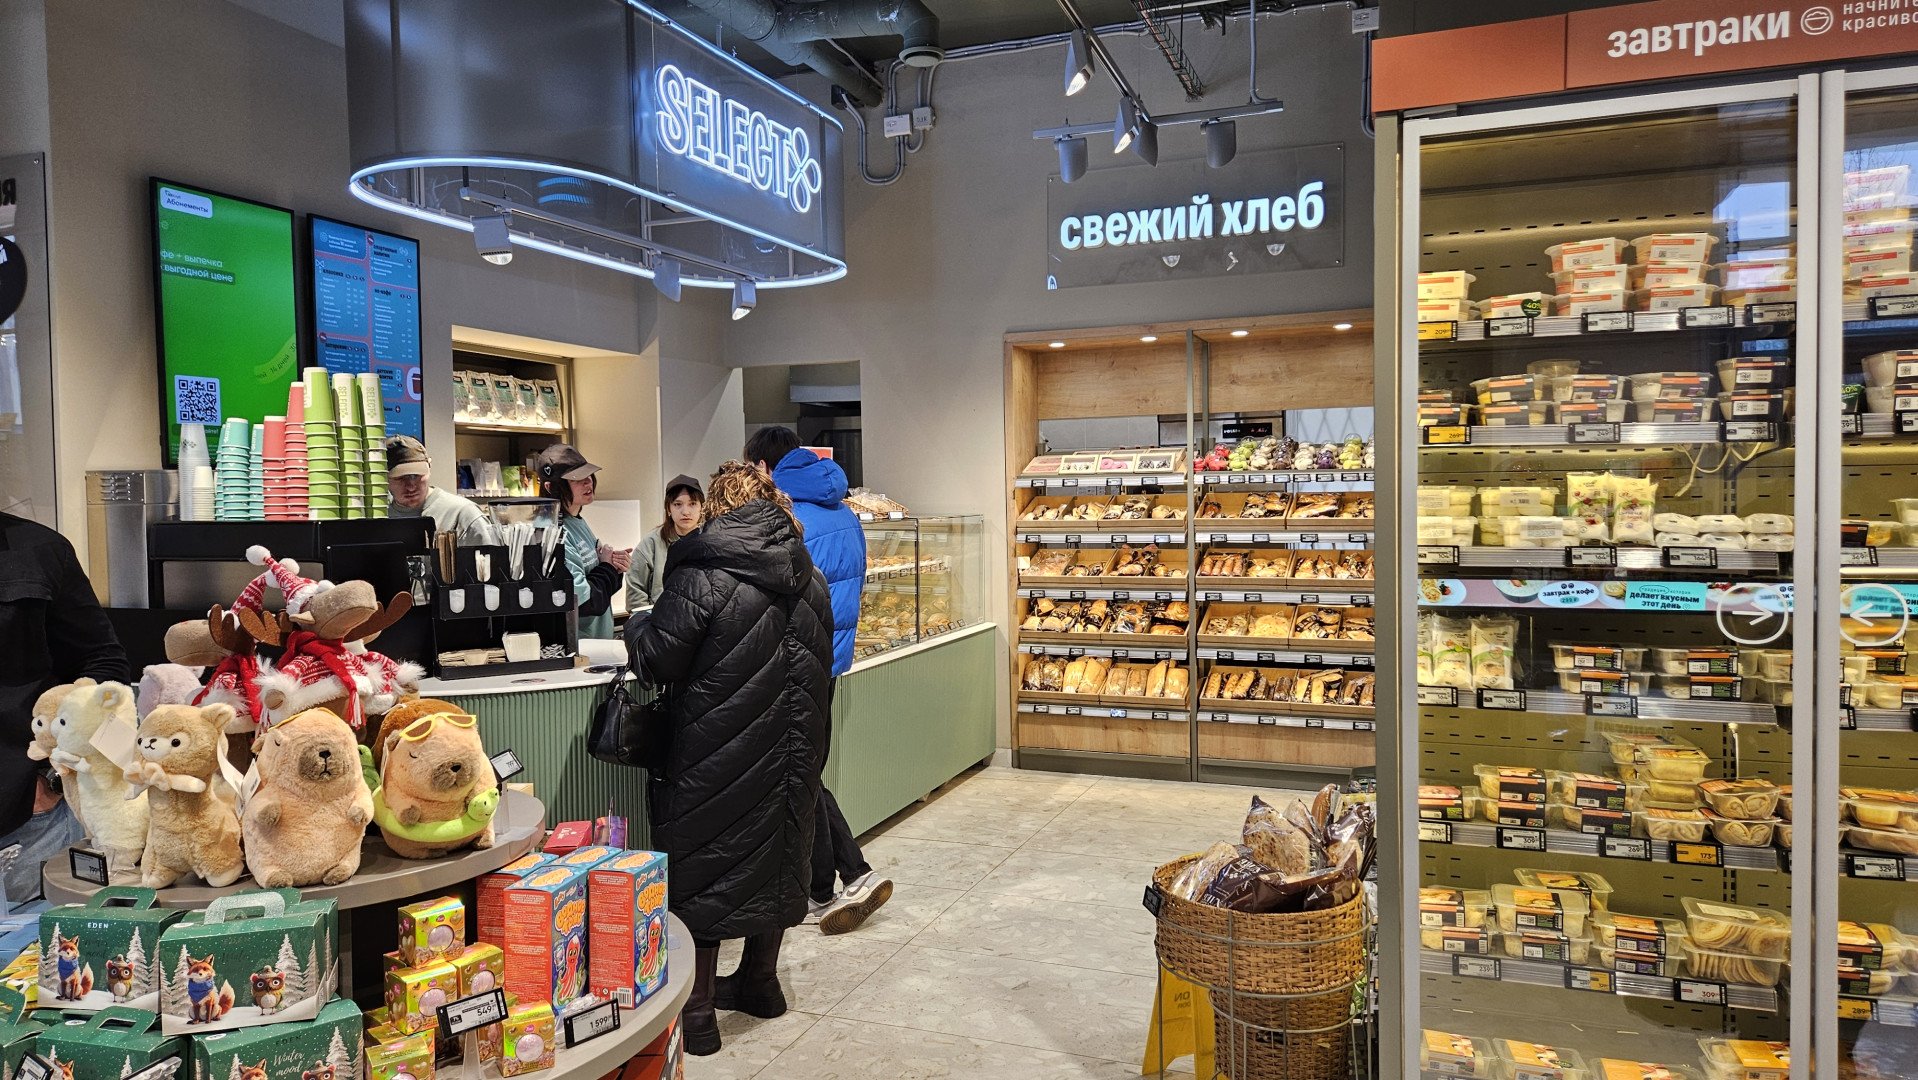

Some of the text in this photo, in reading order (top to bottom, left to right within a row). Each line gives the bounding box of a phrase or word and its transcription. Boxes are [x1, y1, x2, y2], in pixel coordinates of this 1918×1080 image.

[1607, 11, 1790, 57] завтраки
[654, 65, 792, 199] SELECT
[166, 197, 209, 213] Абонементы
[1060, 181, 1326, 250] свежий хлеб
[184, 254, 223, 267] выпечка
[164, 264, 233, 282] выгодной цене
[1629, 592, 1700, 603] делает вкусным
[1641, 600, 1681, 610] этот день
[477, 1005, 491, 1017] 549
[273, 1049, 305, 1067] Winter
[275, 1064, 302, 1077] mood
